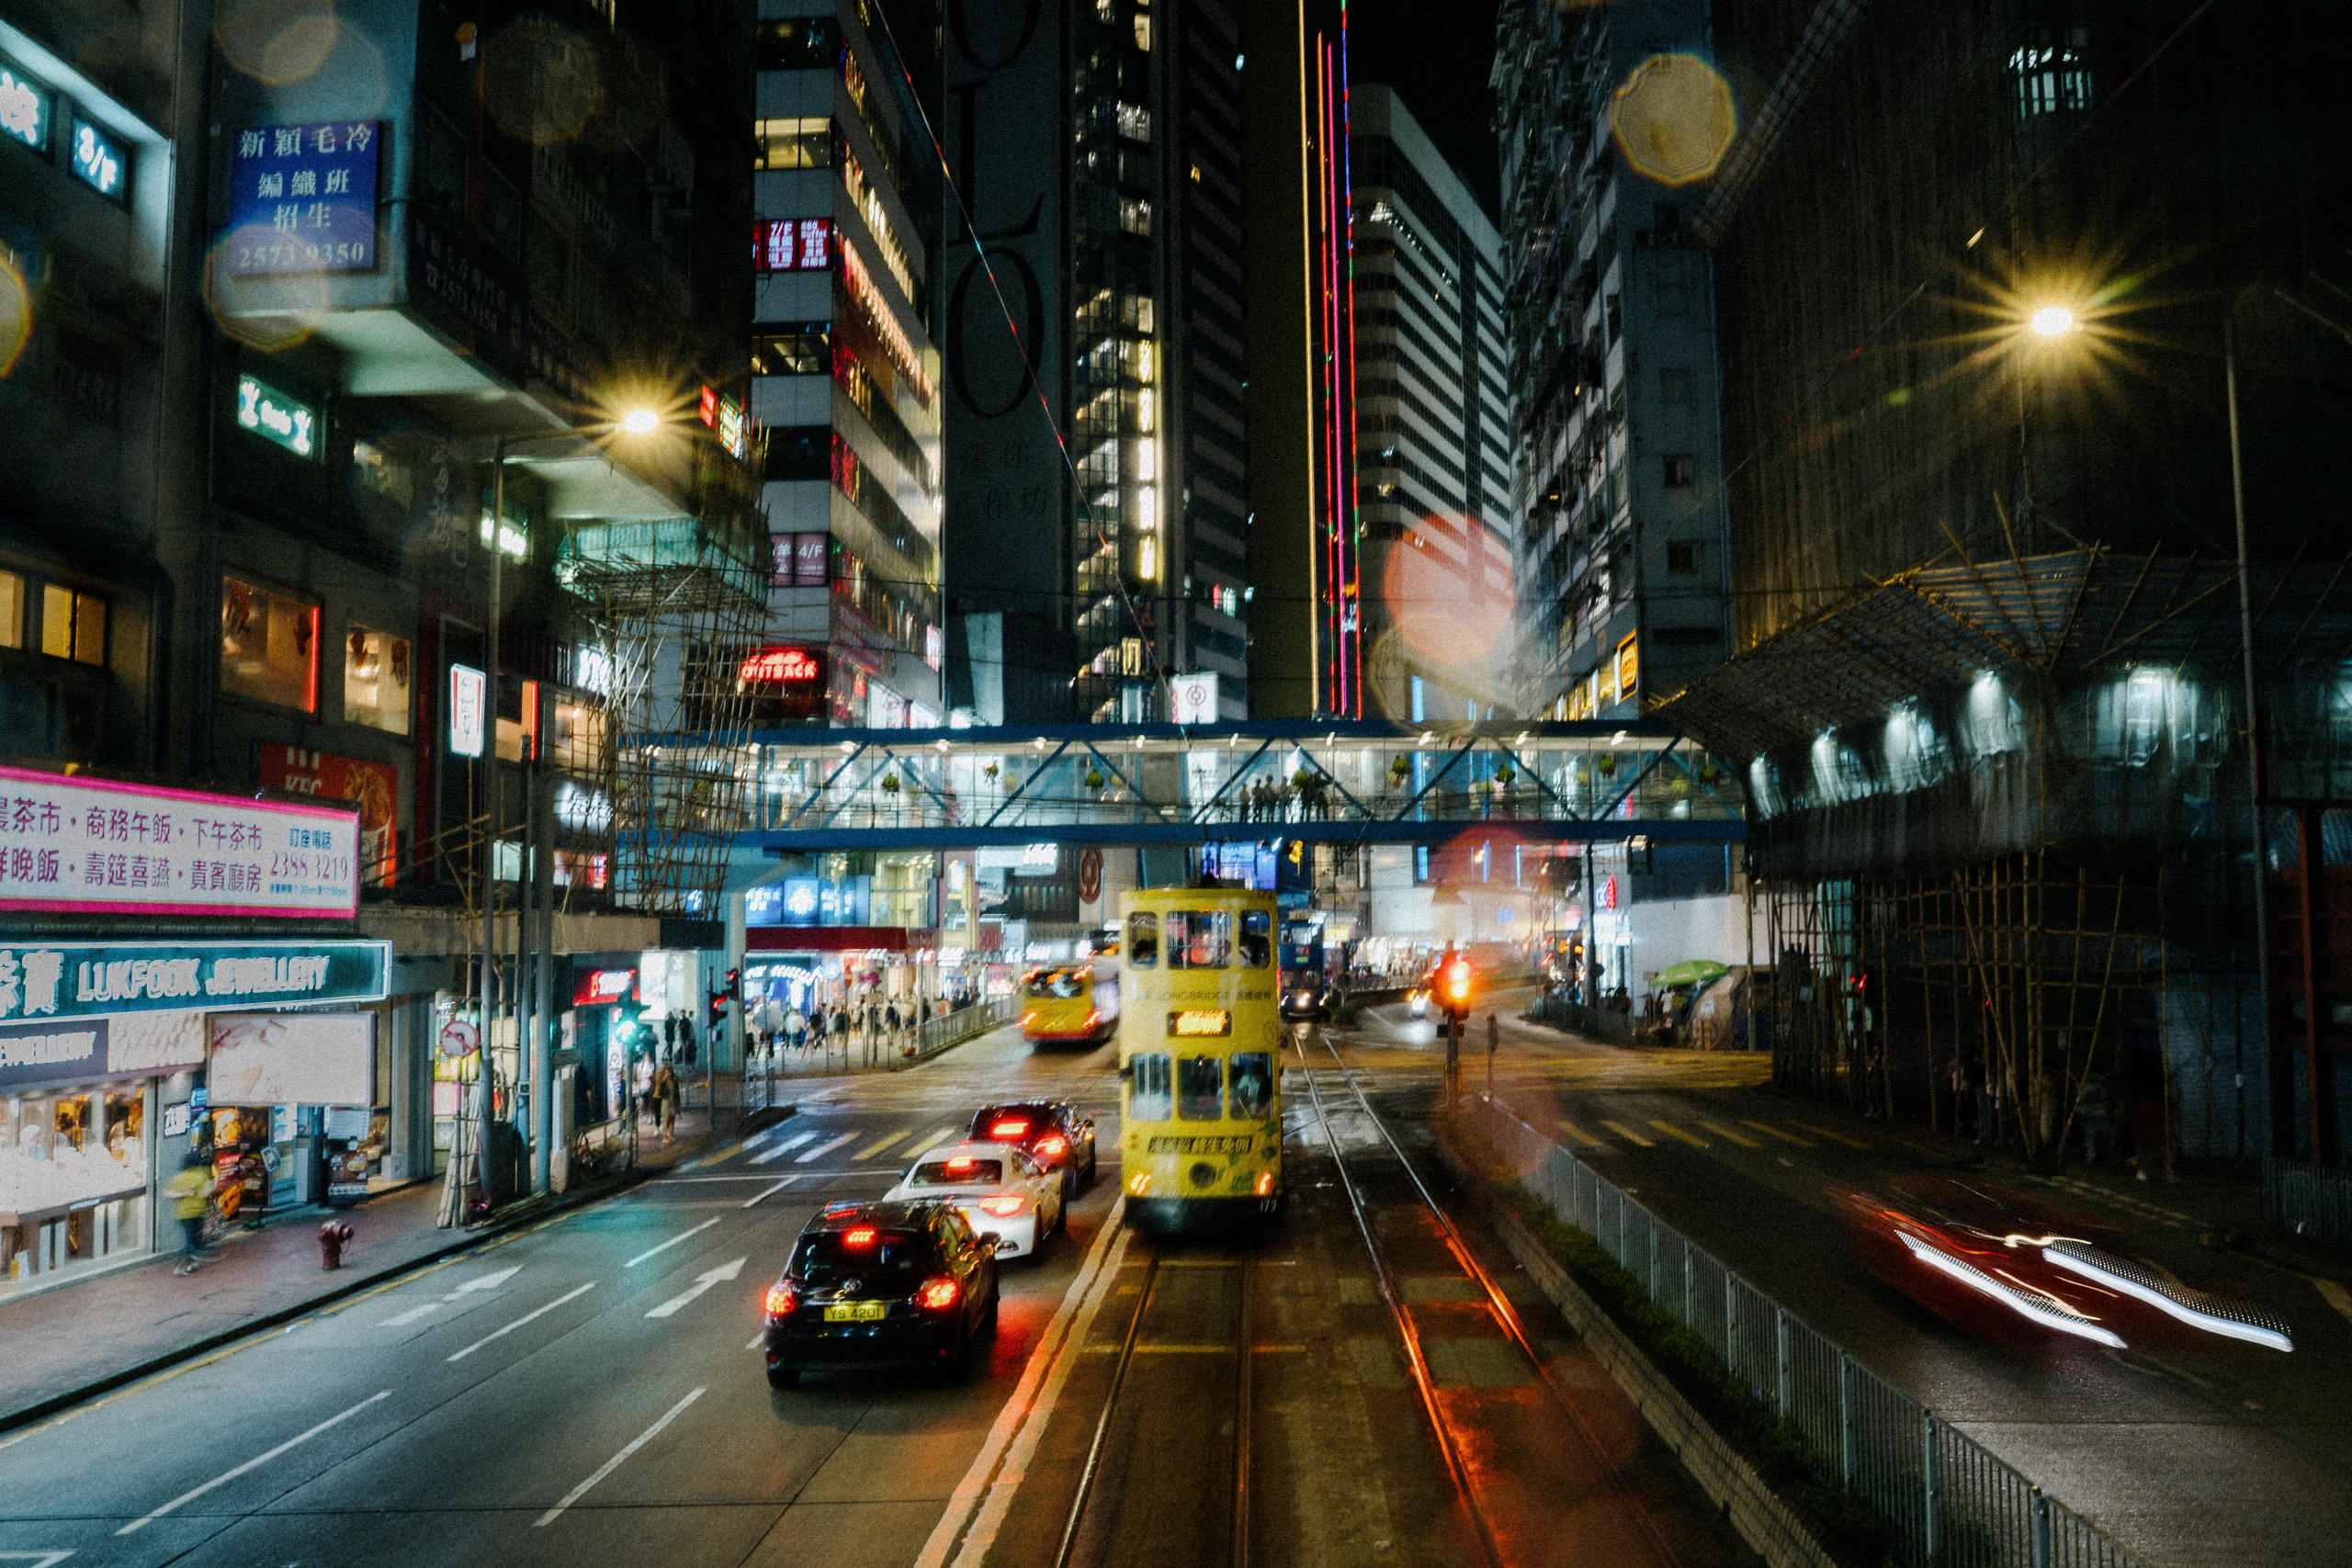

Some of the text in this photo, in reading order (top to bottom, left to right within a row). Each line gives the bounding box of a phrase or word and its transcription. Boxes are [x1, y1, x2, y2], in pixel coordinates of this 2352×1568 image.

[239, 123, 372, 158] 新穎毛冷
[258, 168, 350, 198] 編織班
[274, 202, 331, 230] 招生
[771, 220, 793, 236] 7/F
[239, 243, 365, 268] 2573 9350
[798, 541, 823, 558] 4/F
[741, 661, 817, 680] OUTBACK
[86, 806, 171, 843] 商務午飯
[191, 818, 263, 853] 下午茶市
[289, 828, 332, 851] 訂座電話
[270, 851, 347, 881] 2388 3219
[76, 958, 201, 1002] LUKFOOK
[204, 955, 331, 996] JEWELLERY
[831, 1308, 879, 1319] YS 4201
